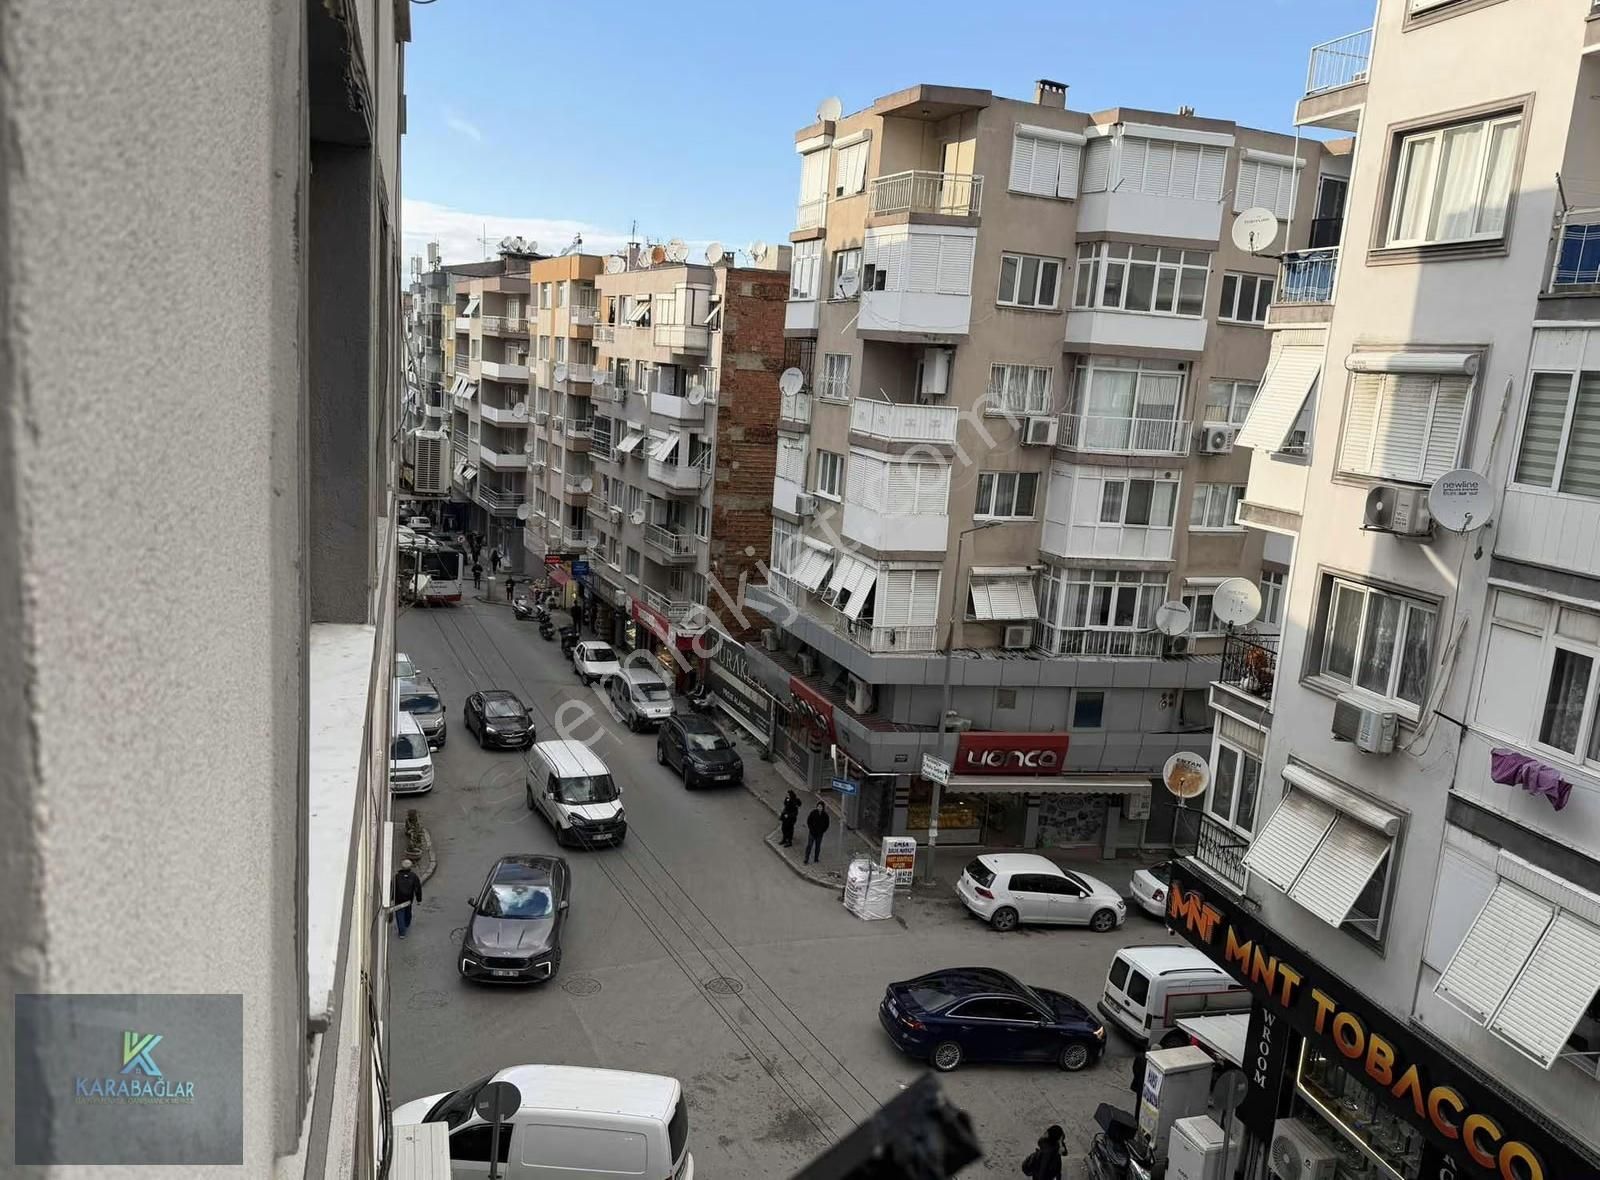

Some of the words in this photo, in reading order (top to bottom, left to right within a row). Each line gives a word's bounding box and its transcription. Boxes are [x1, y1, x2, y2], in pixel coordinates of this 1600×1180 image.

[1443, 481, 1479, 489] newline
[1170, 882, 1222, 945] MNT
[1225, 924, 1300, 1008] MNT
[1312, 988, 1544, 1180] TOBACCO
